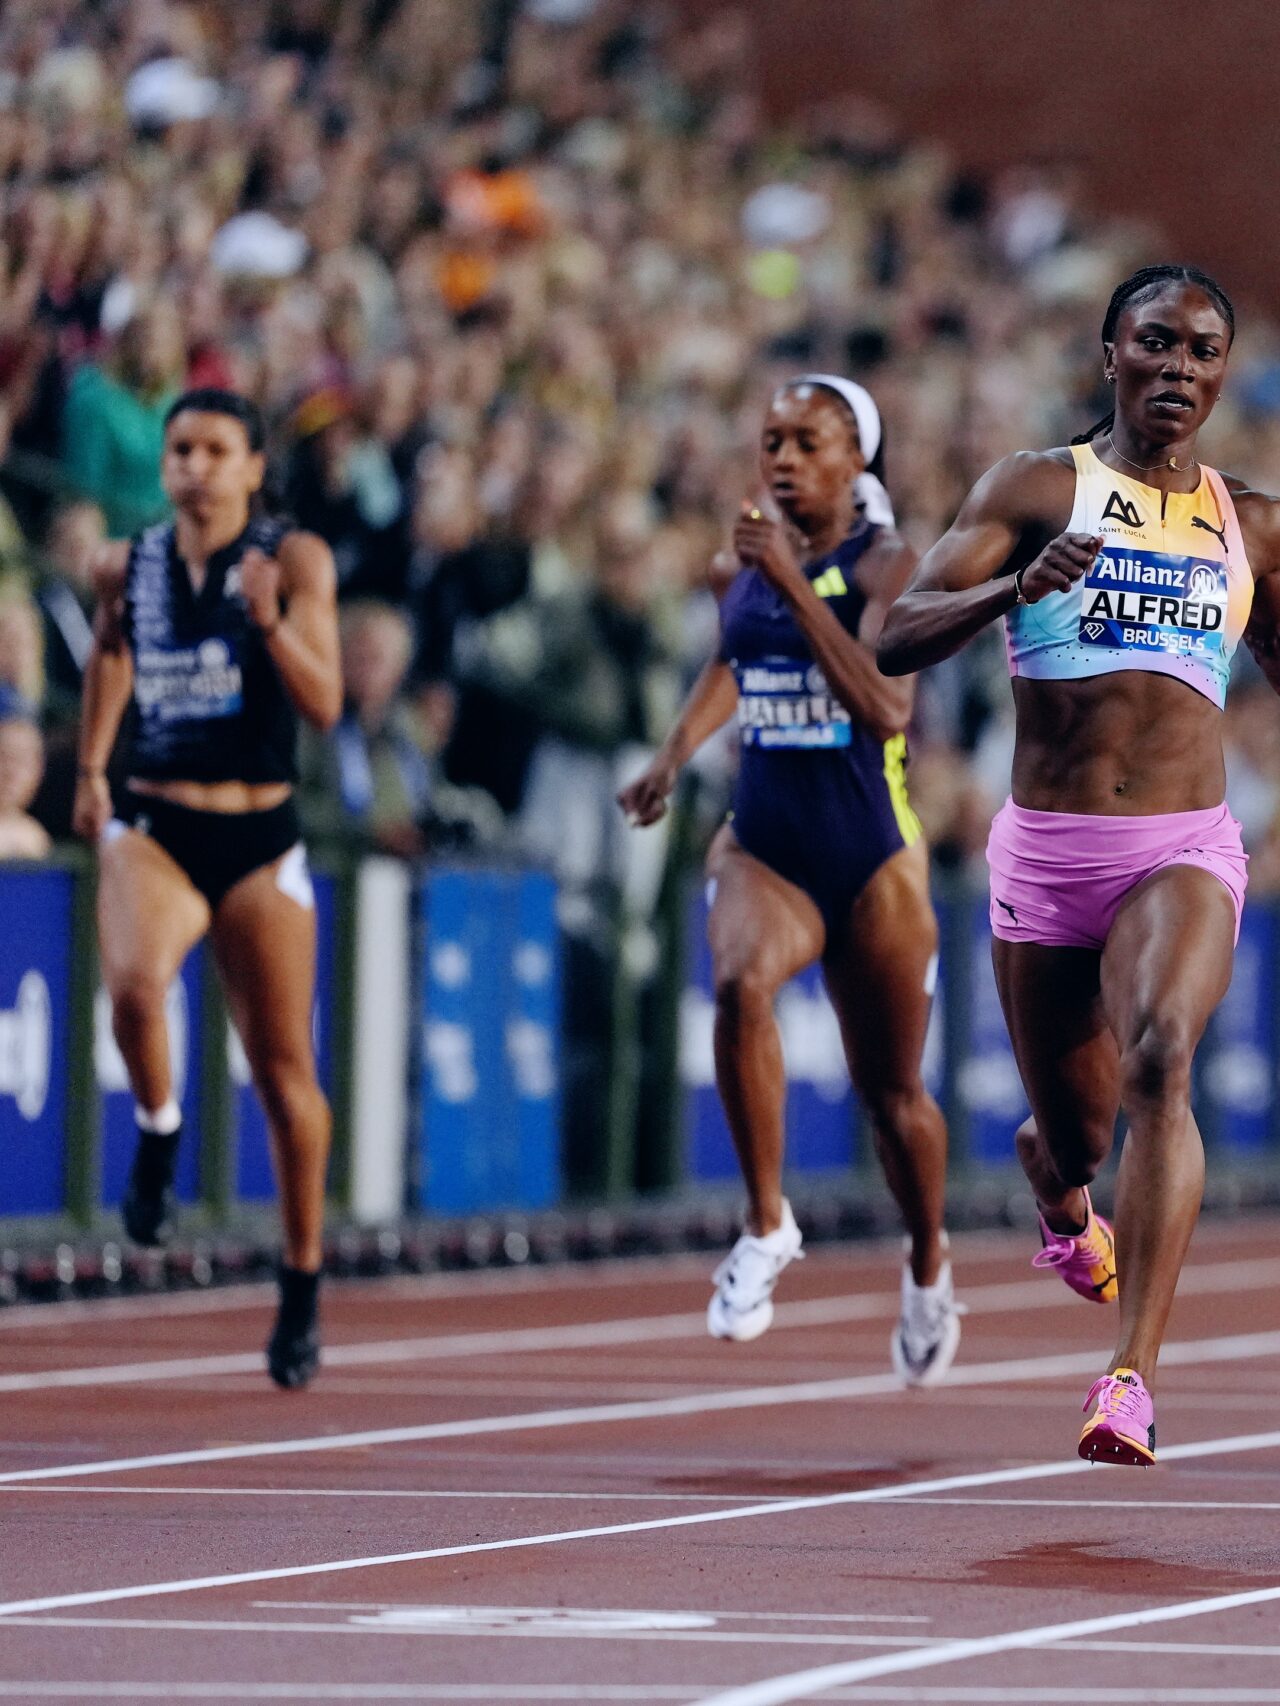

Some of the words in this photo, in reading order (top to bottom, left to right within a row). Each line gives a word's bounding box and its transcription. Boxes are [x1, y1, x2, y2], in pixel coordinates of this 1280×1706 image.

[1124, 529, 1147, 540] LUCIA
[1097, 557, 1185, 588] Allianz
[1087, 590, 1222, 631] ALFRED
[1123, 628, 1206, 651] BRUSSELS
